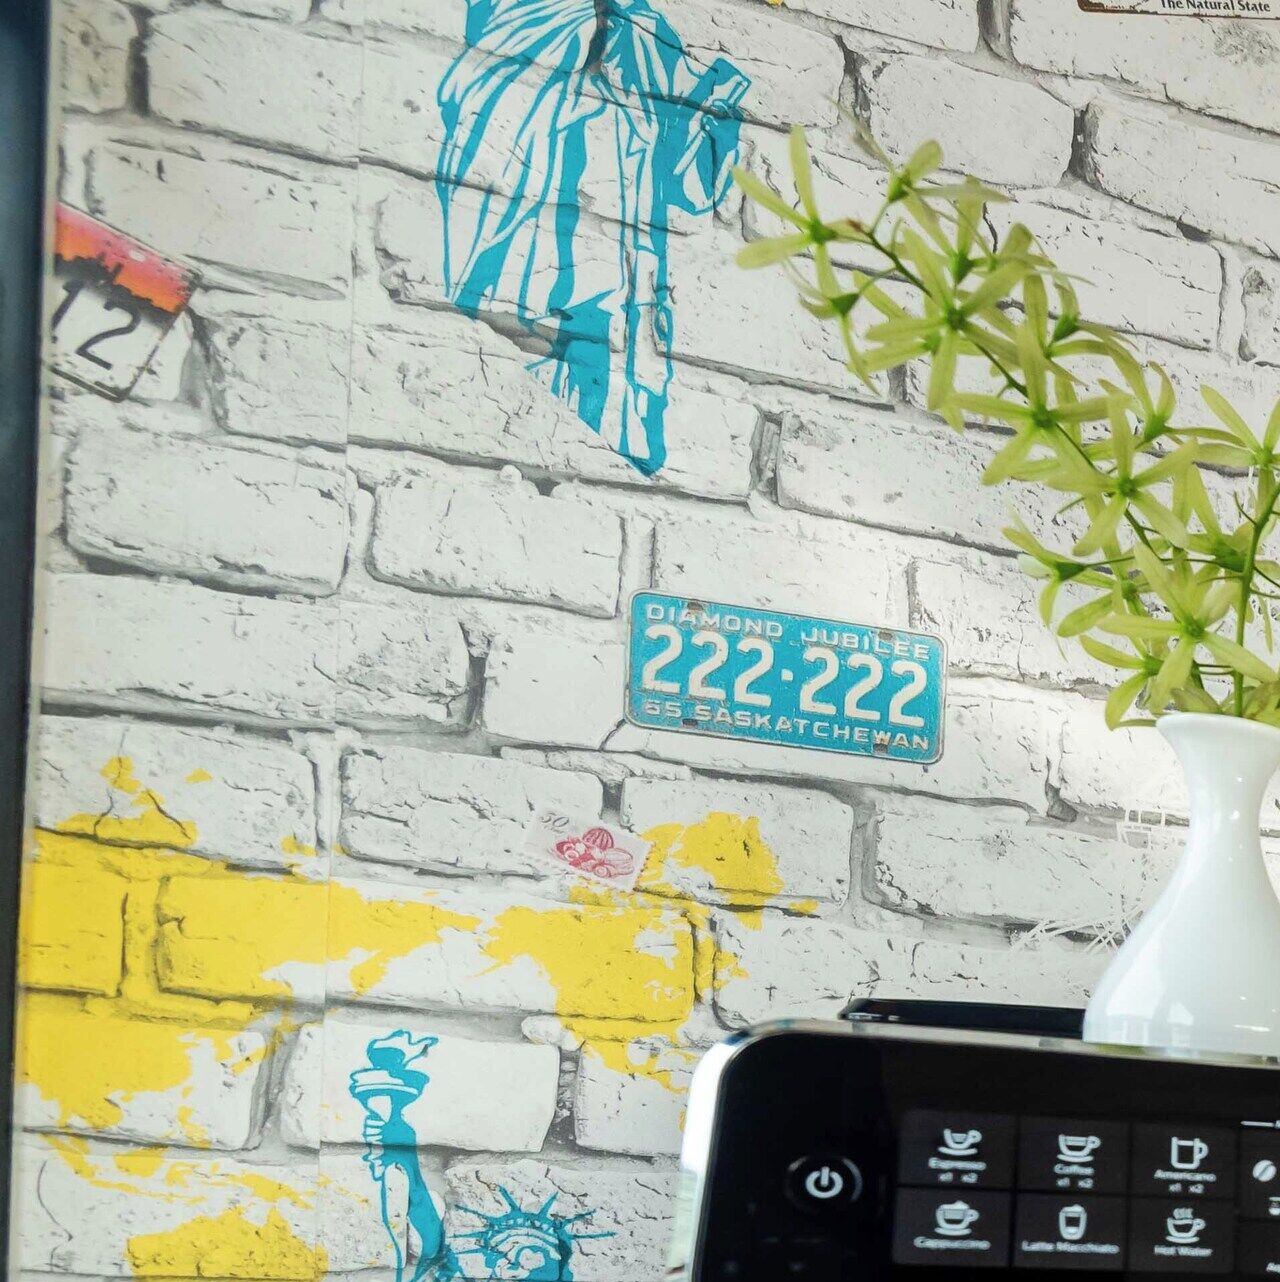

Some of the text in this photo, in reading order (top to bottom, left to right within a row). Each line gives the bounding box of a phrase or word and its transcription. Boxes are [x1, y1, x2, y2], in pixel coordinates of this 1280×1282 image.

[645, 603, 931, 661] DIAMOND JUBILEE
[644, 700, 930, 751] 65 SASKATCHEWAN
